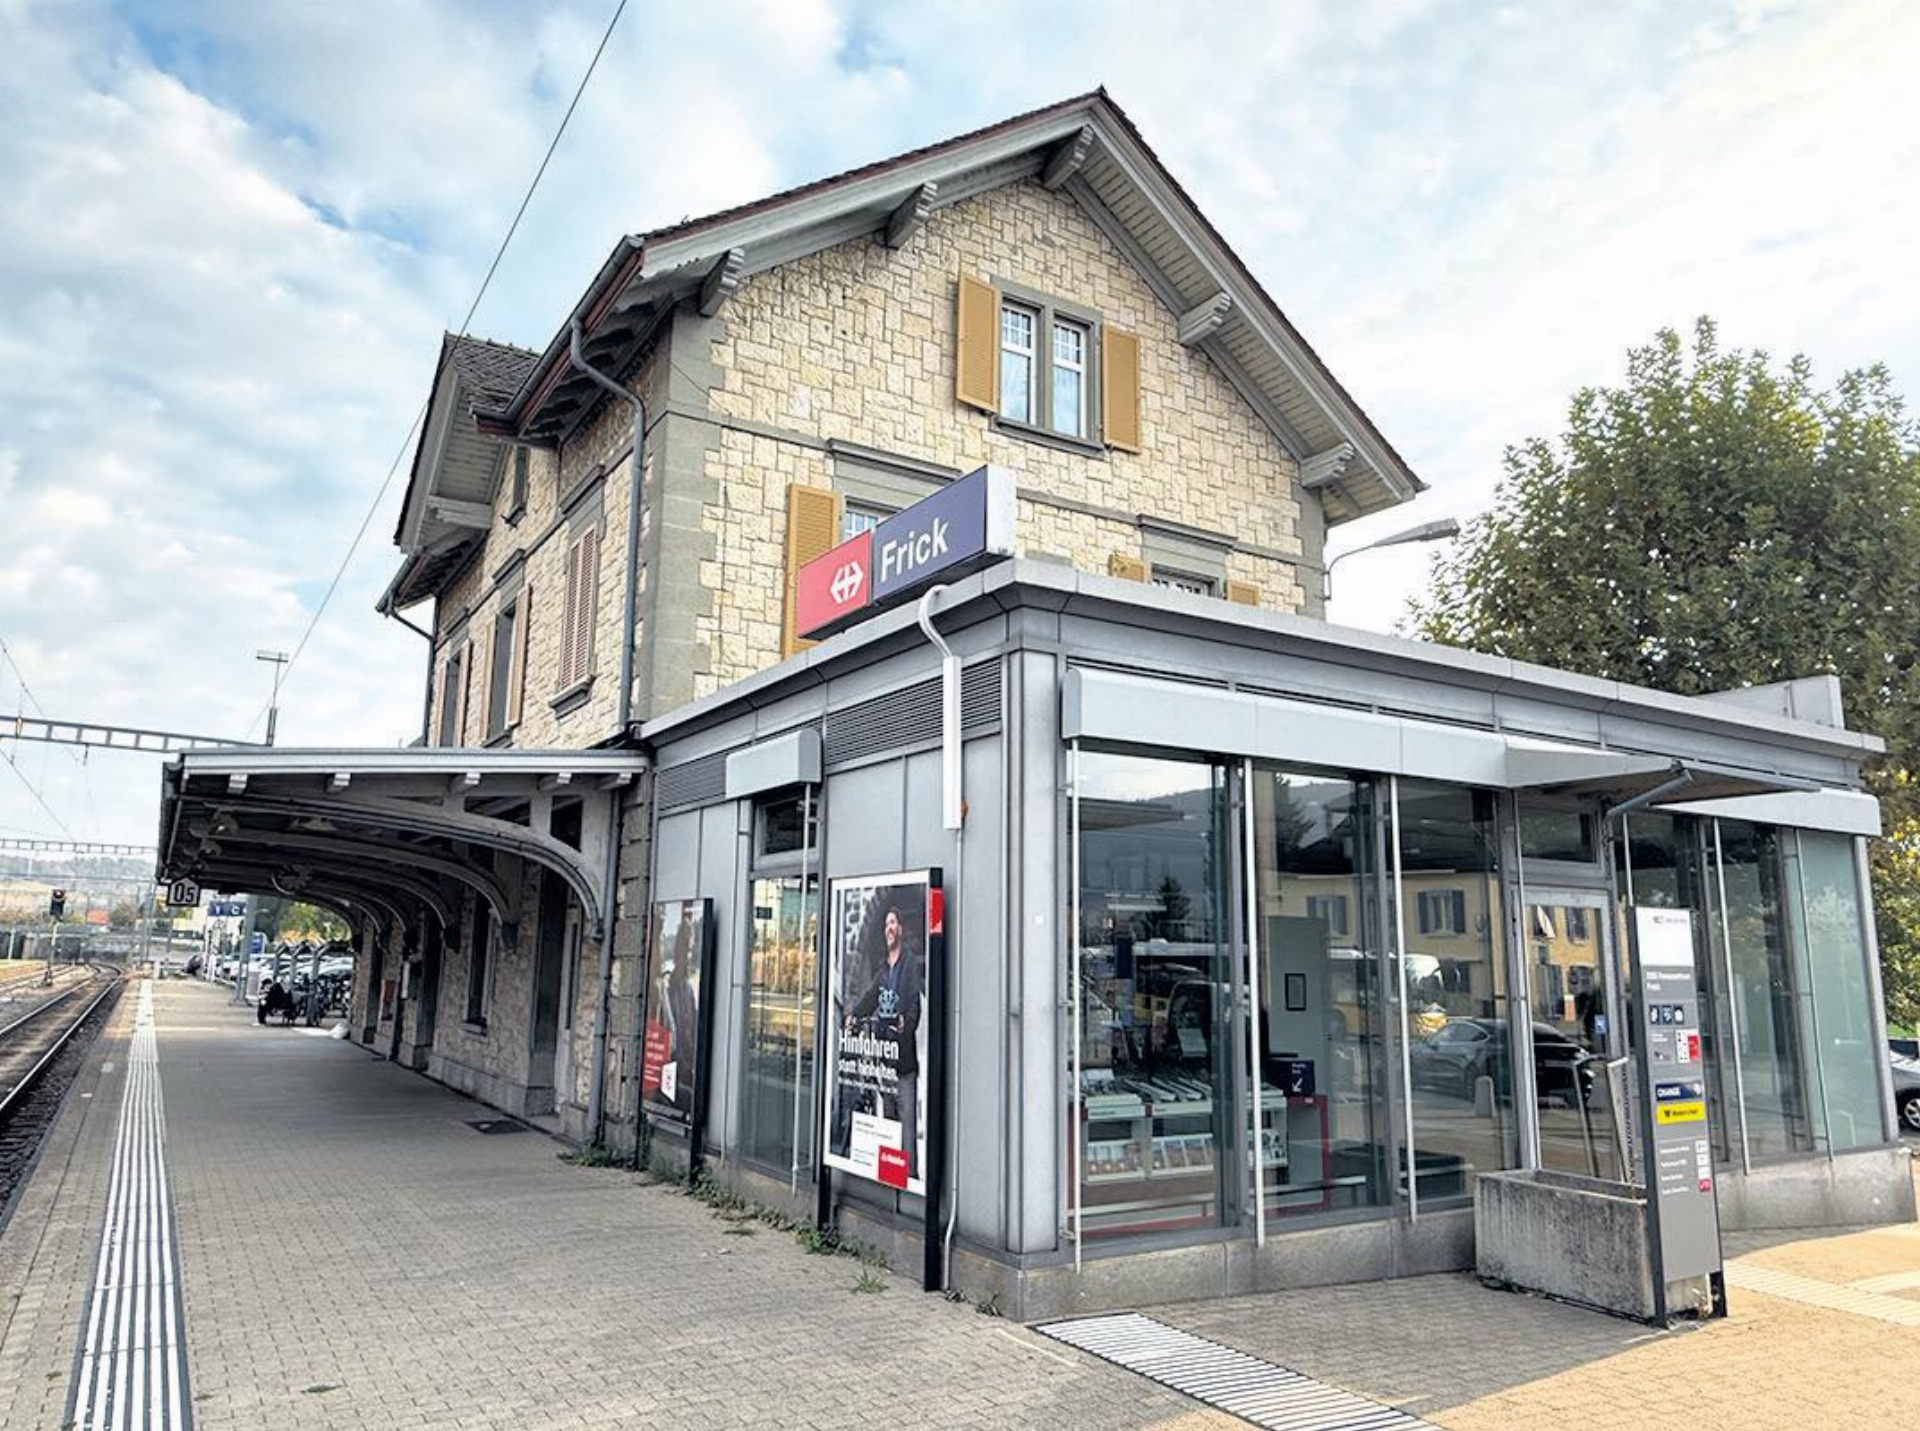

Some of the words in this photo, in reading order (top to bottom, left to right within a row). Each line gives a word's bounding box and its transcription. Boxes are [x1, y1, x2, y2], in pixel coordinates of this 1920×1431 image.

[880, 517, 949, 582] Frick
[174, 883, 195, 903] 05
[839, 1029, 899, 1060] Hinfahren
